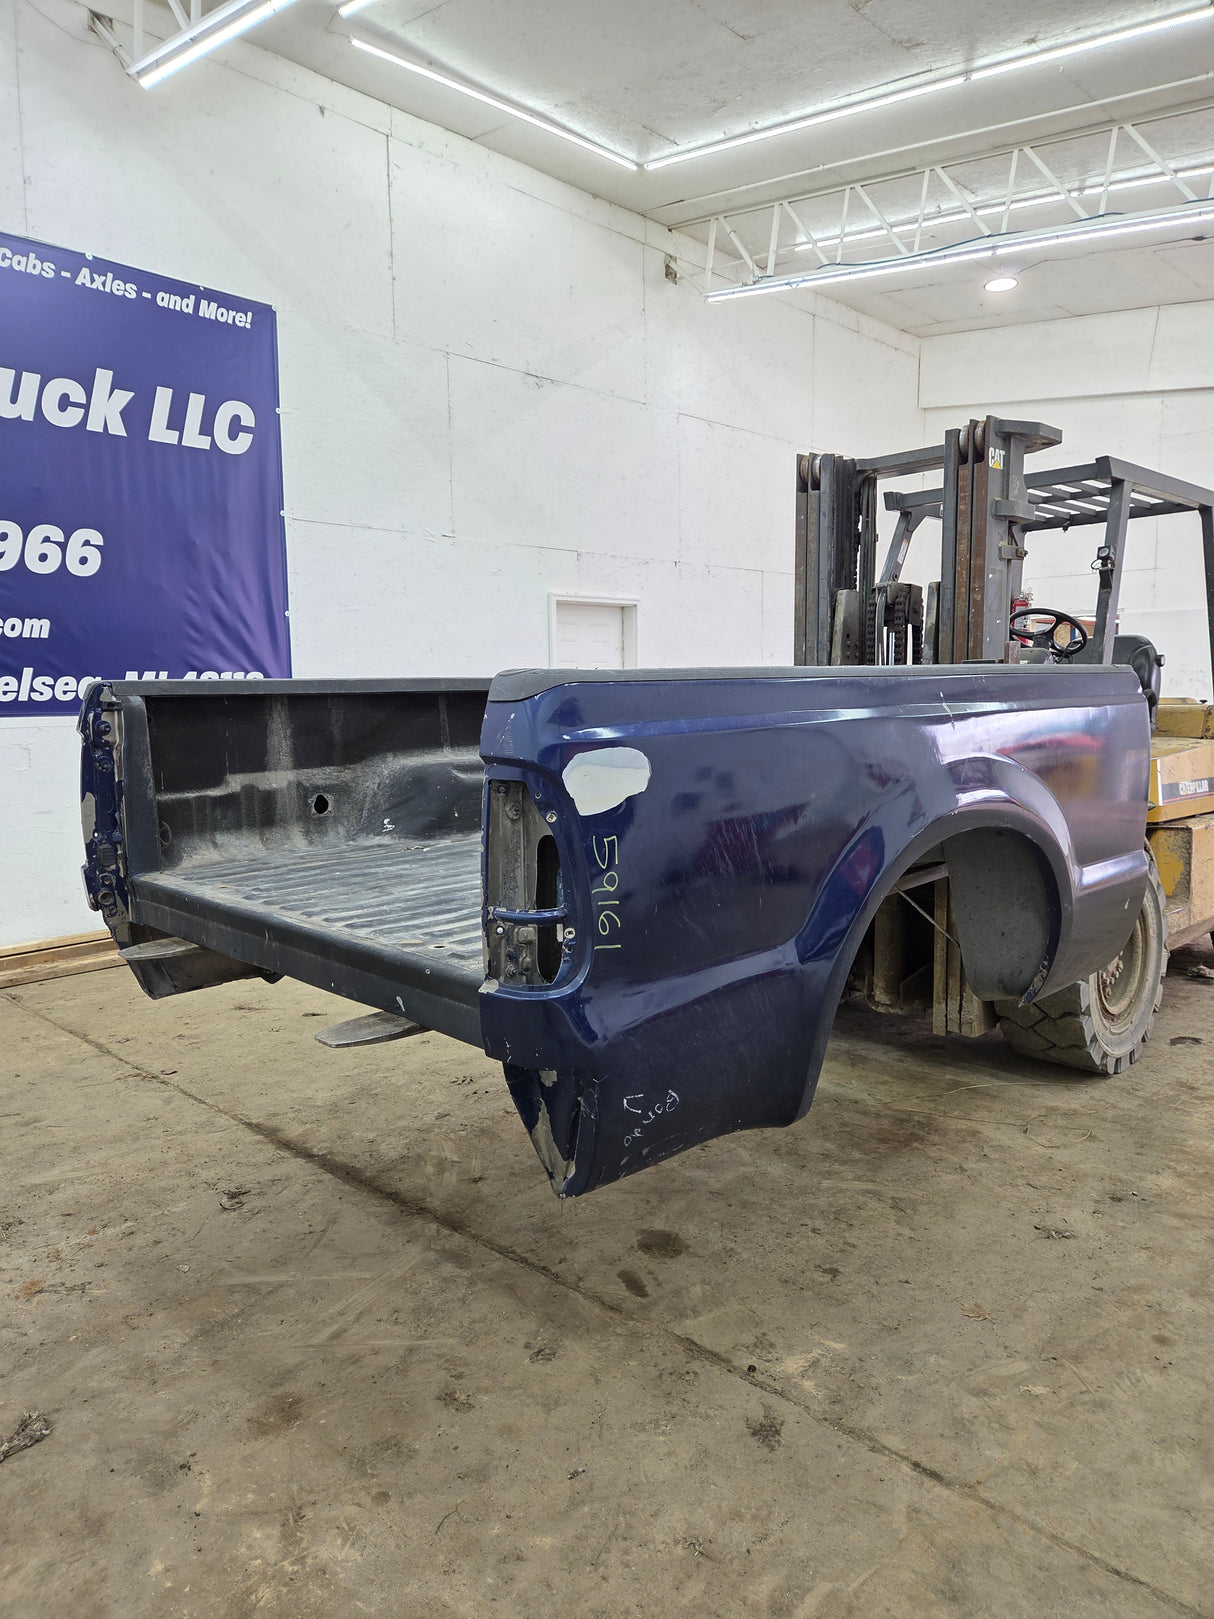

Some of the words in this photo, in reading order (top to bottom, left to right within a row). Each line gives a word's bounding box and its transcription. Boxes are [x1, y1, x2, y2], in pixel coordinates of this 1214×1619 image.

[0, 247, 56, 278] Cabs
[75, 267, 138, 299] Axles
[156, 290, 195, 314] and
[199, 300, 253, 329] More!
[148, 386, 256, 455] LLC
[989, 447, 1006, 470] CAT
[0, 617, 51, 638] om
[591, 835, 622, 950] 59161
